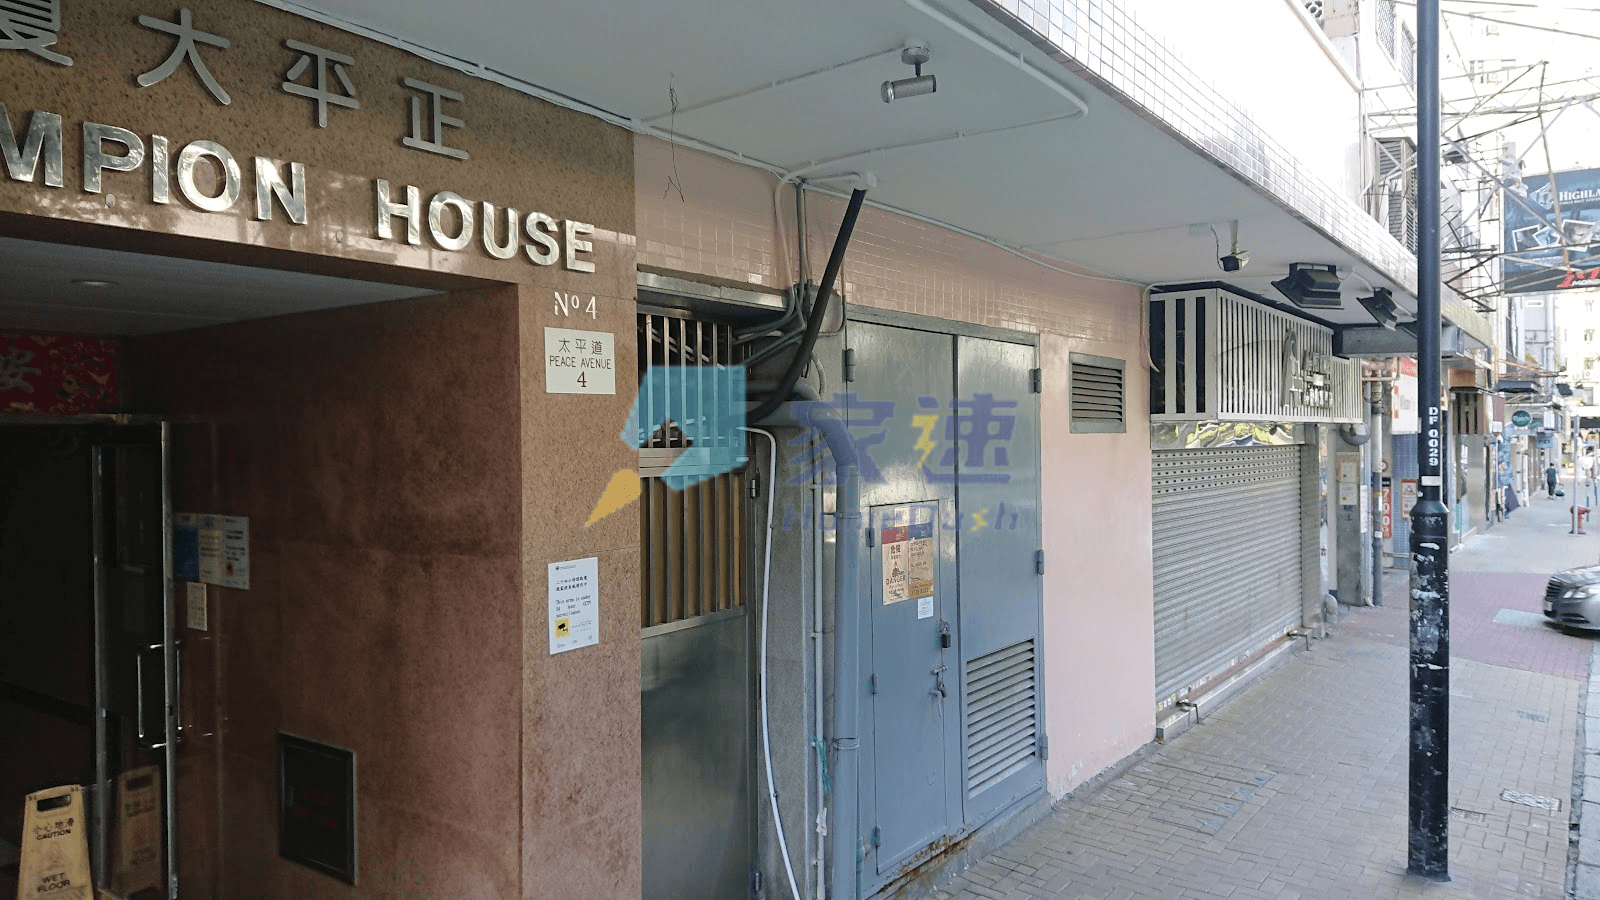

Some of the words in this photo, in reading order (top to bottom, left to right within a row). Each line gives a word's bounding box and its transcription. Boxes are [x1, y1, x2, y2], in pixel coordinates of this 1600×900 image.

[0, 104, 307, 226] MPION
[376, 178, 596, 273] HOUSE
[585, 295, 597, 320] 4
[558, 338, 603, 355] 太平道
[549, 355, 576, 368] PEACE
[581, 357, 612, 370] AVENUE
[576, 371, 588, 388] 4
[1428, 406, 1439, 425] DF
[1428, 428, 1439, 467] 0029
[36, 828, 72, 841] CAUTION
[37, 880, 71, 893] FLOOR
[42, 872, 65, 884] WET
